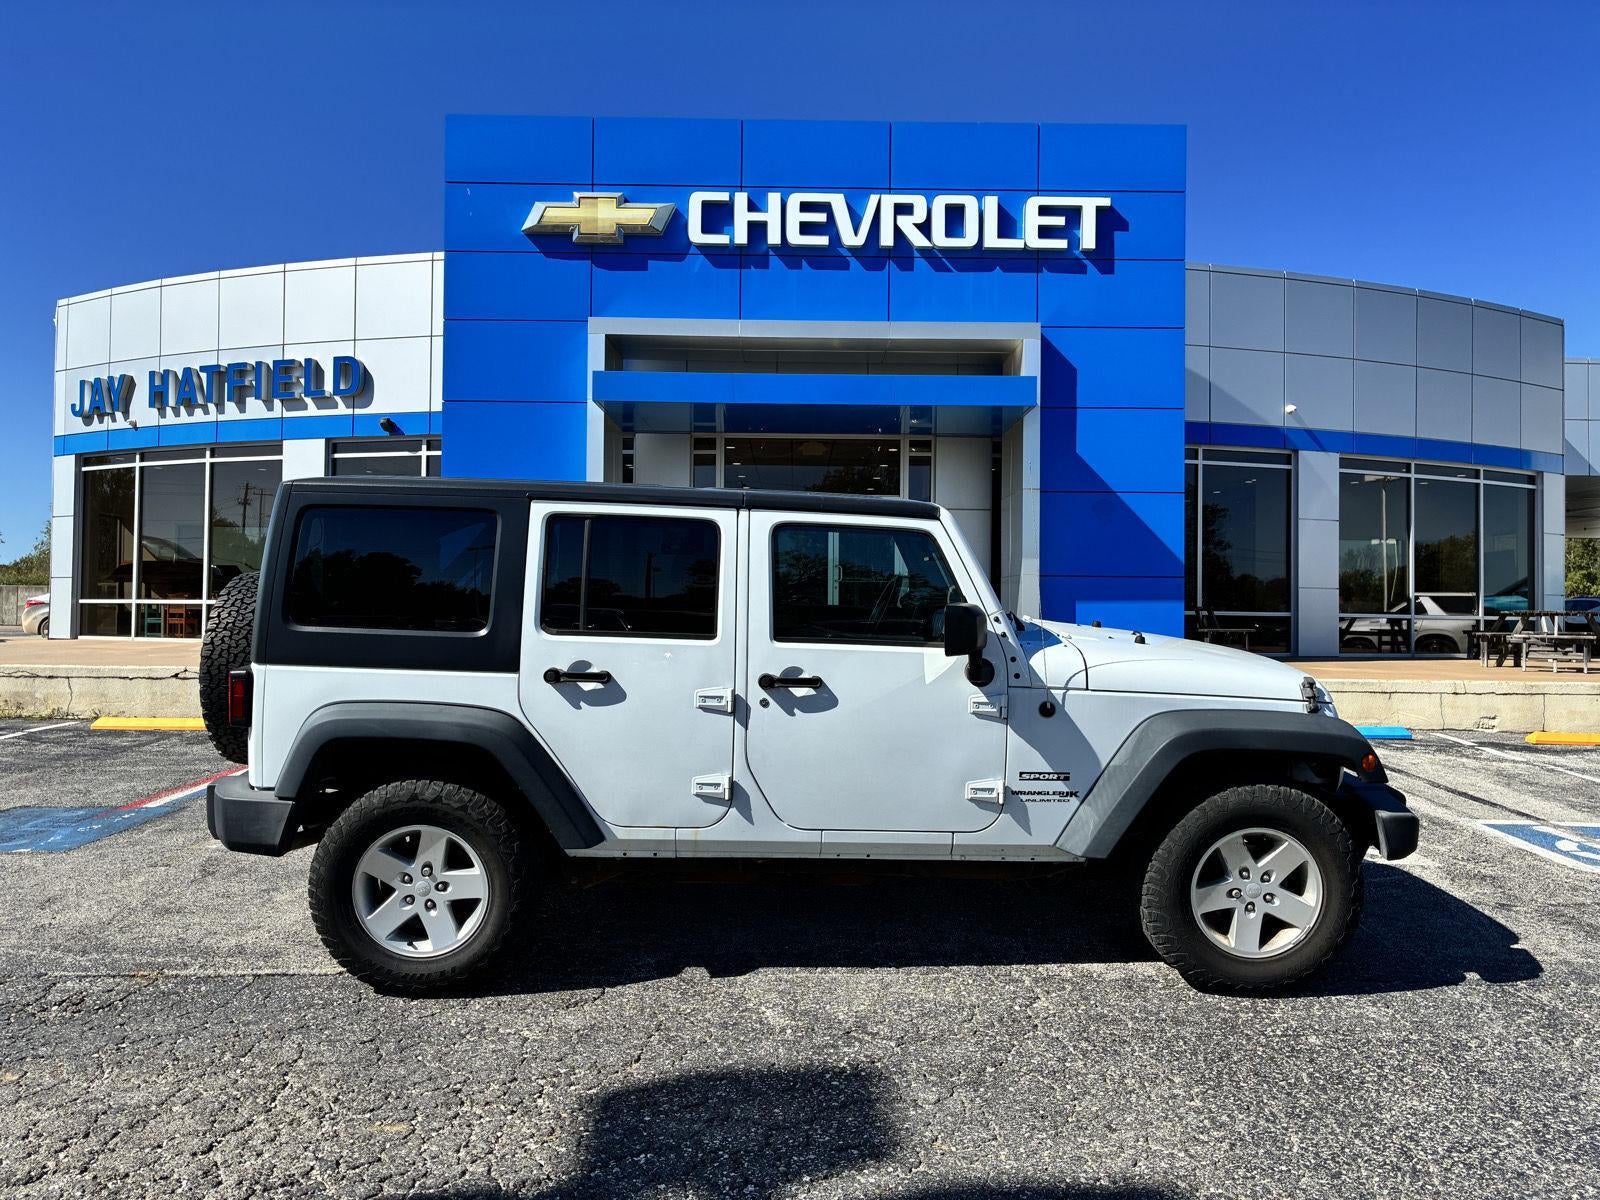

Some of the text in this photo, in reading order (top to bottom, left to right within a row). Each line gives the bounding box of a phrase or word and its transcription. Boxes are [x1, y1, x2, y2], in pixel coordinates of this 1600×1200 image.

[687, 191, 1112, 253] CHEVROLET
[71, 355, 362, 418] JAY HATFIELD
